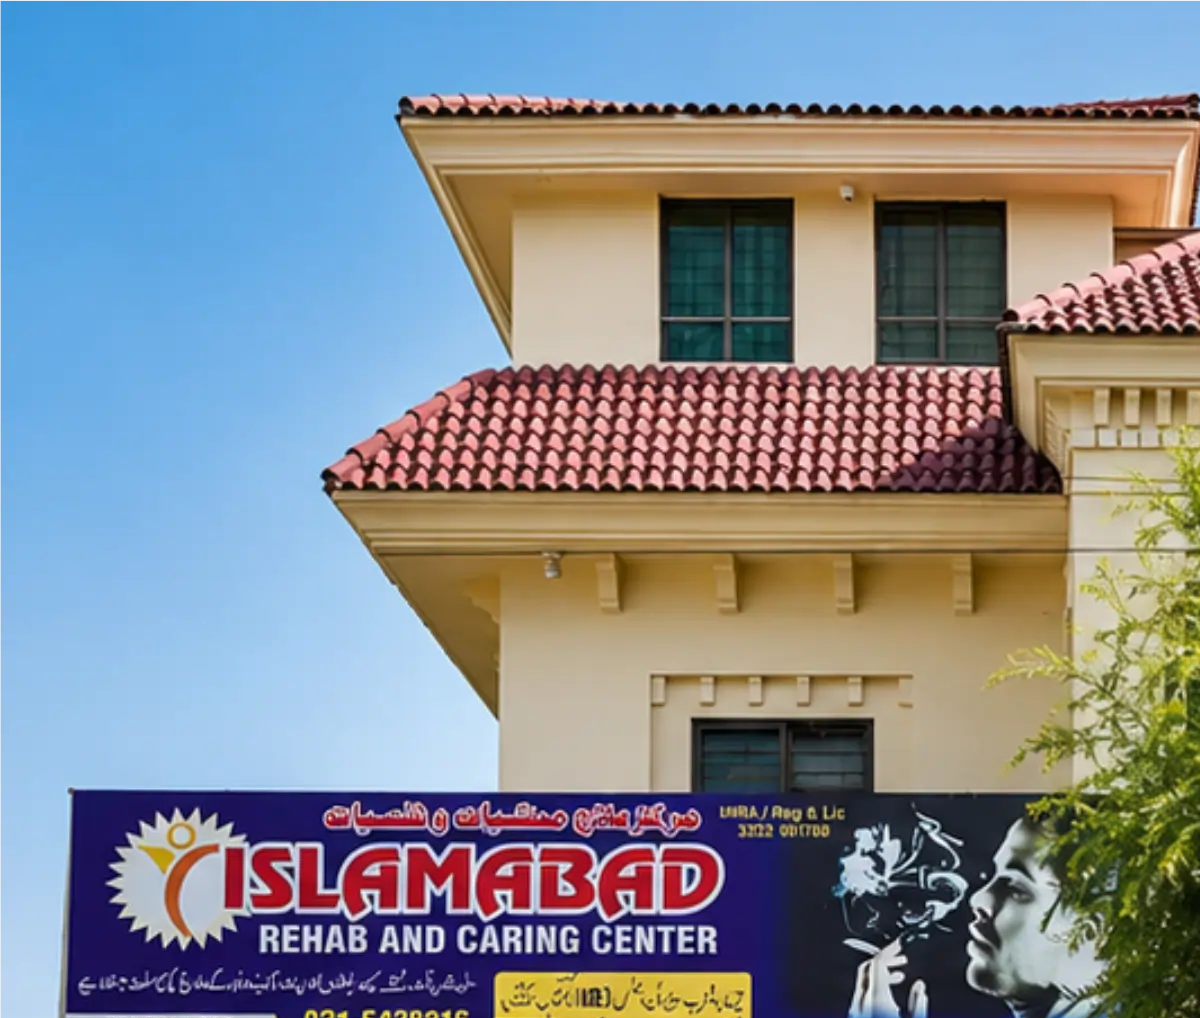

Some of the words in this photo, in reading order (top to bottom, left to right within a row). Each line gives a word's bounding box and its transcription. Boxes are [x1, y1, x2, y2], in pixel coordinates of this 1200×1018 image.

[222, 842, 726, 922] ISLAMABAD
[259, 924, 368, 955] REHAB
[379, 924, 446, 955] AND
[457, 924, 580, 955] CARING
[591, 924, 718, 955] CENTER
